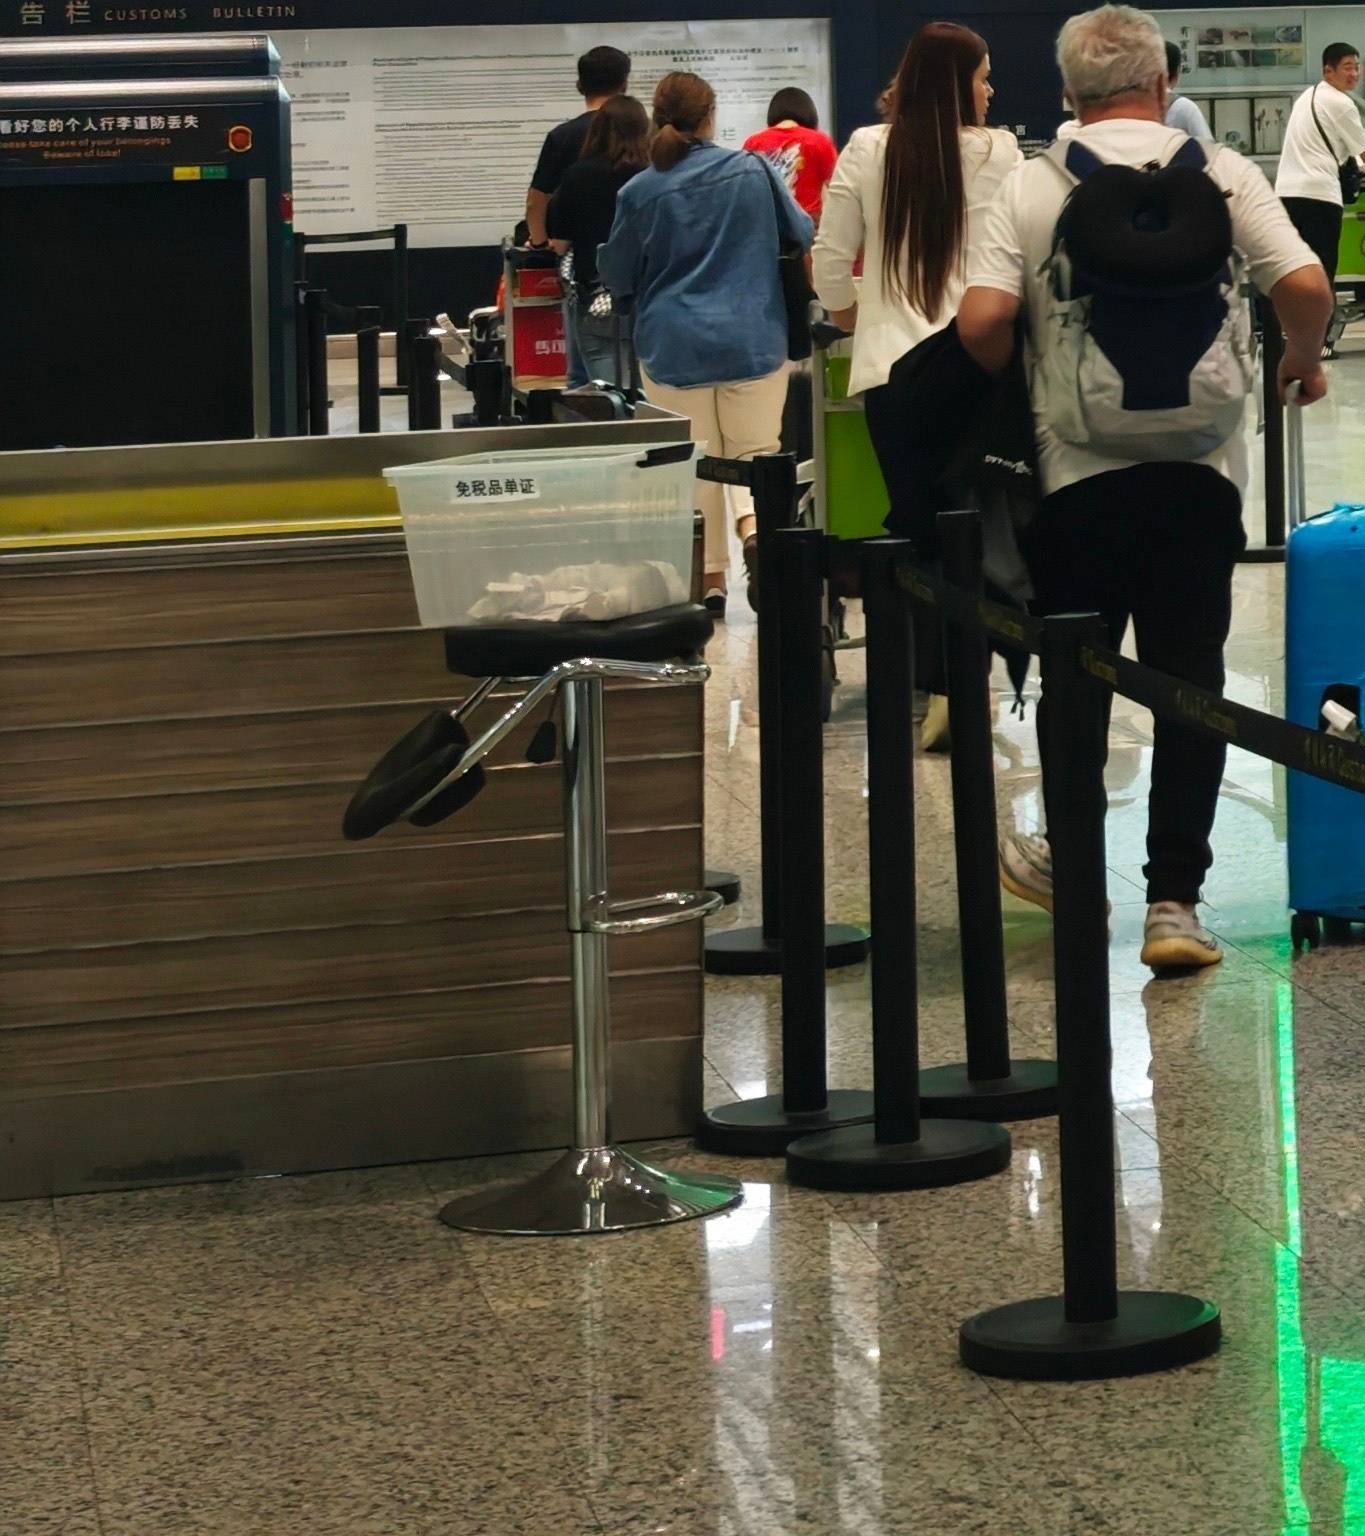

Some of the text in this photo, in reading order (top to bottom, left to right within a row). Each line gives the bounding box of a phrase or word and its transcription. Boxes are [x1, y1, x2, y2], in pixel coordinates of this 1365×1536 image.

[104, 5, 296, 21] CUSTOMS BULLETIN
[455, 478, 536, 498] 免税品单证
